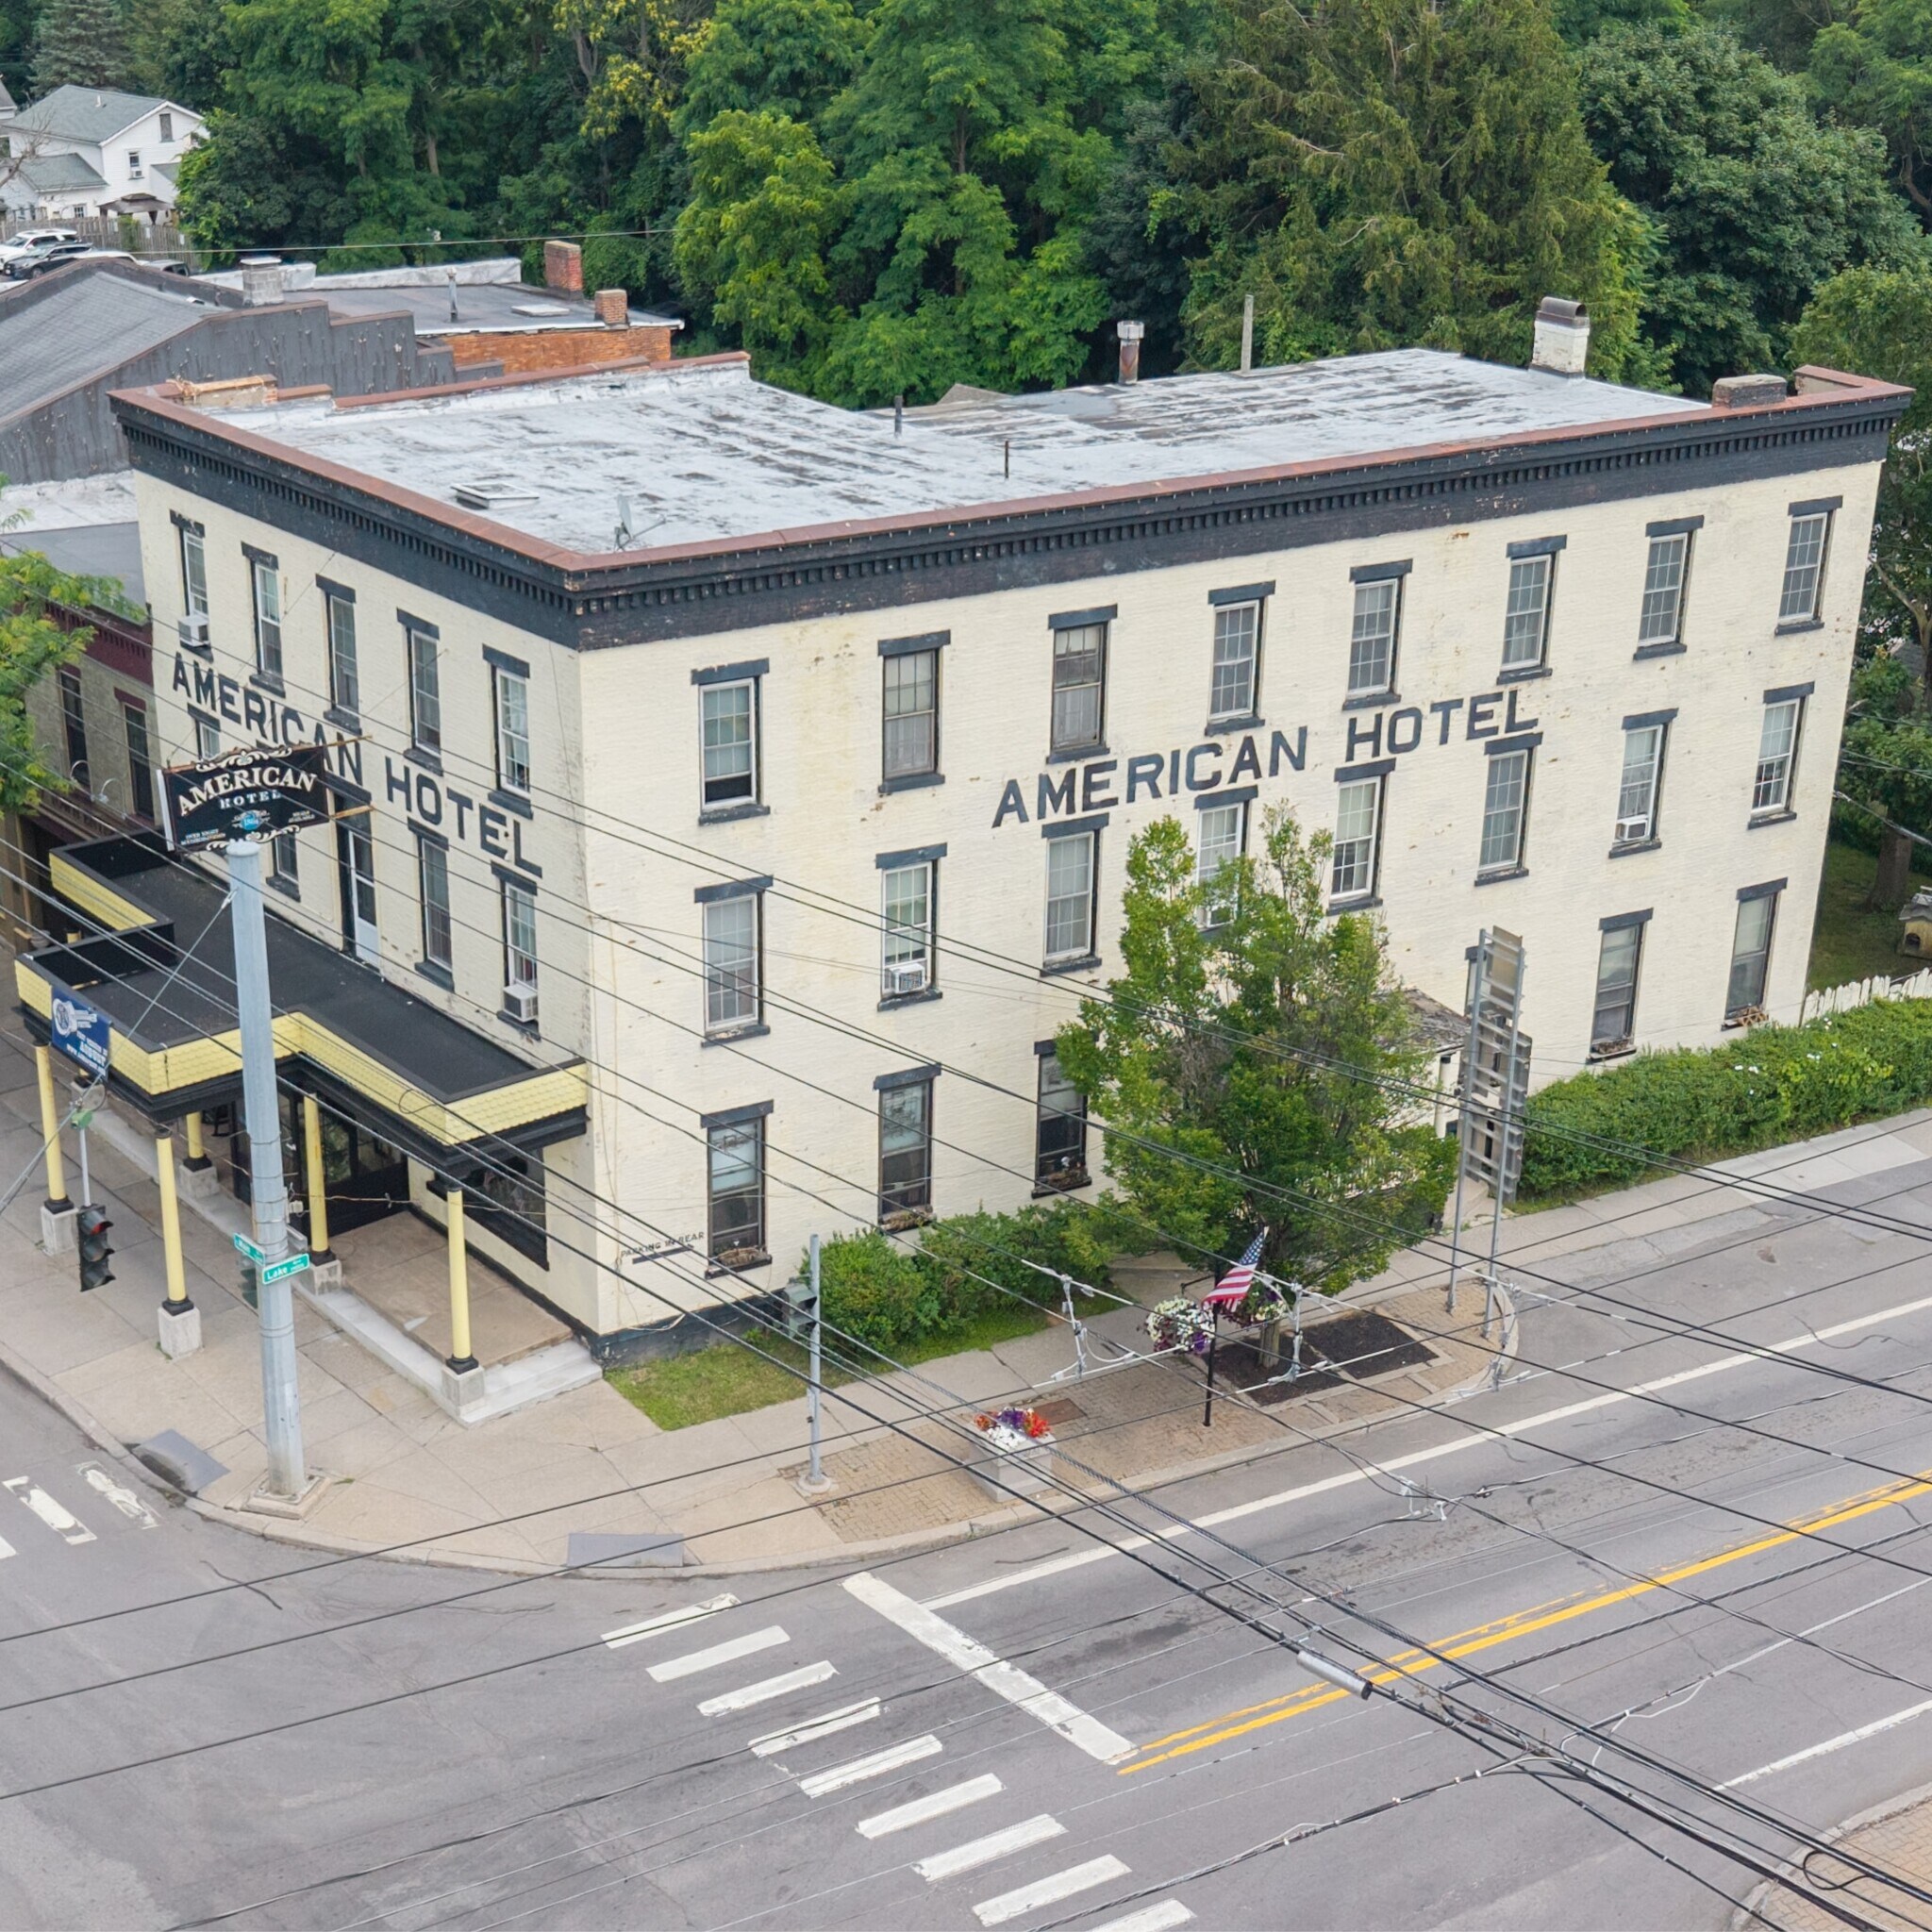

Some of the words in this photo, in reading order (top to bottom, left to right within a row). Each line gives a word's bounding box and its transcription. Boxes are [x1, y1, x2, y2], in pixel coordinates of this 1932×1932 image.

[173, 652, 362, 785] AMERICAN
[385, 756, 543, 879] HOTEL
[992, 725, 1307, 828] AMERICAN
[1346, 690, 1539, 761] HOTEL
[178, 767, 318, 816] AMERICAN
[220, 790, 283, 809] HOTEL
[678, 1232, 705, 1243] REAR
[267, 1266, 288, 1279] Lake
